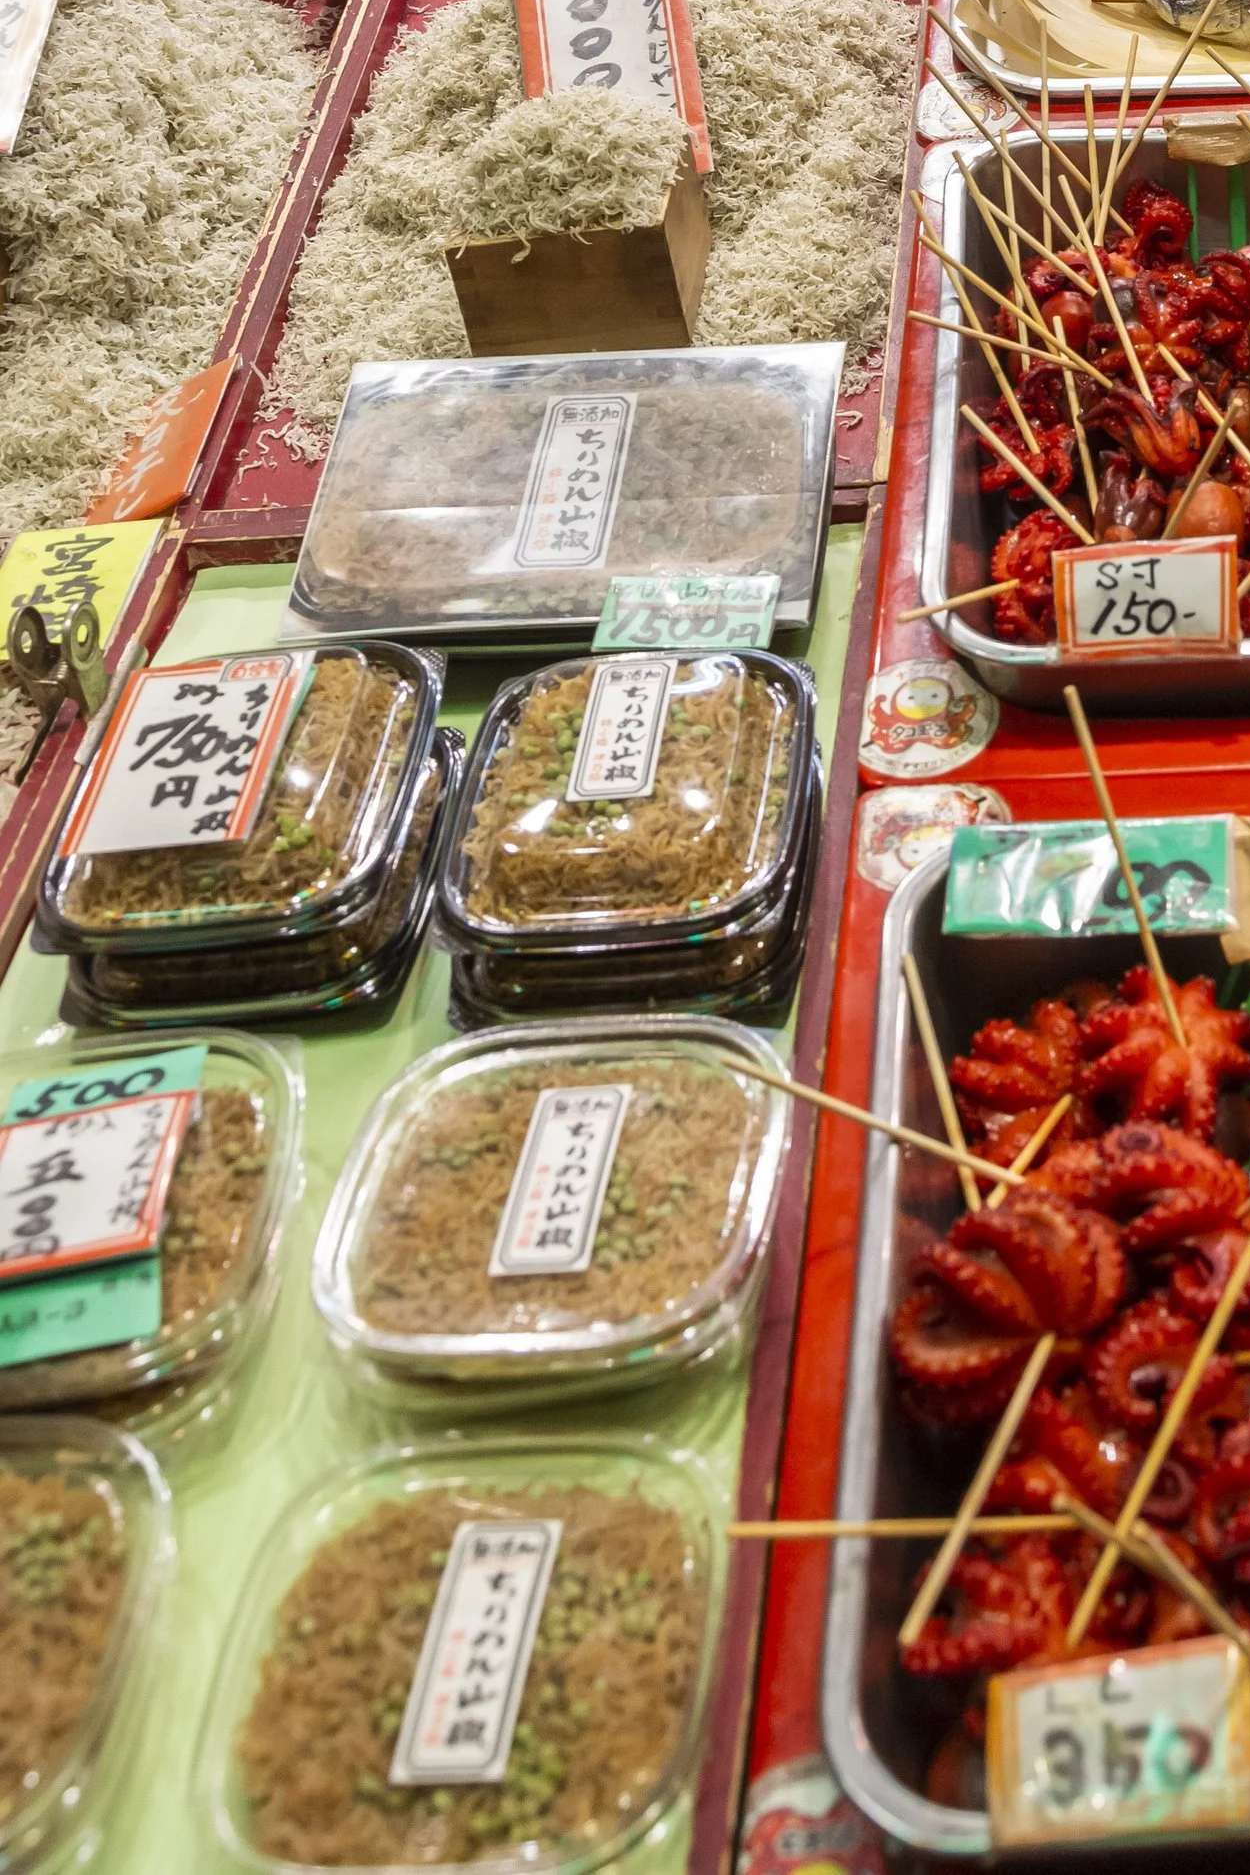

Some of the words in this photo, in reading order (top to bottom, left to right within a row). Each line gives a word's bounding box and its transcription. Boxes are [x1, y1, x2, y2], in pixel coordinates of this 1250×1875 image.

[561, 405, 620, 424] 無添加
[550, 428, 606, 551] ちりめん山椒
[604, 686, 649, 782] ちりめん山椒
[14, 1066, 166, 1119] 500
